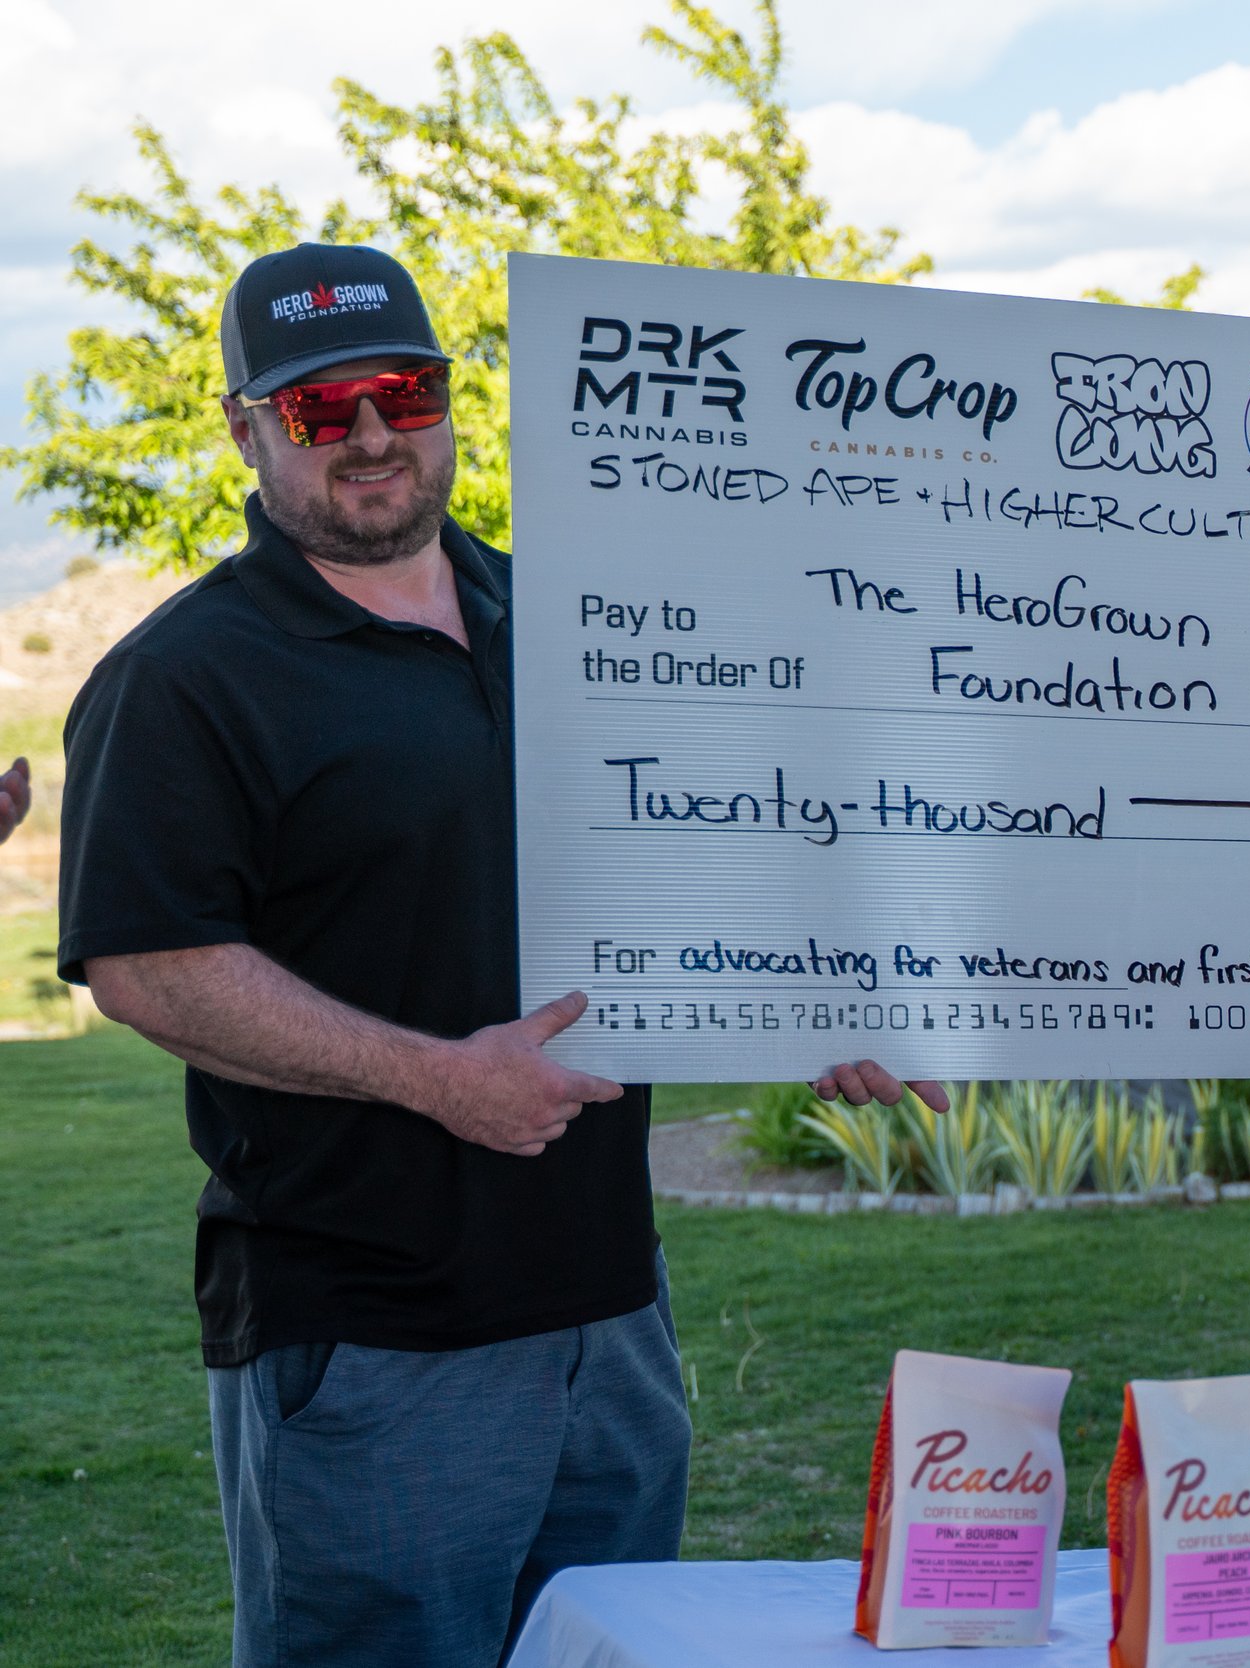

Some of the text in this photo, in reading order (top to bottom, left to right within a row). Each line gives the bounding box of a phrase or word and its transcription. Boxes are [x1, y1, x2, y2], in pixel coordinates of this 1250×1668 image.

[271, 284, 389, 319] HERO GROWN
[290, 302, 382, 322] FOUNDATION
[579, 316, 747, 373] DRK
[573, 367, 747, 423] MTR
[571, 421, 749, 447] CANNABIS
[809, 440, 1000, 466] CANNABIS CO.
[588, 450, 790, 506] STONED
[803, 468, 900, 506] APE
[940, 476, 1137, 534] HIGHER
[582, 595, 696, 636] Pay to
[805, 568, 1211, 648] The HeroGrown
[583, 649, 804, 689] the Order Of
[929, 646, 1217, 711] Foundation
[604, 756, 1107, 845] Twenty-thousand
[594, 940, 656, 973] For
[678, 936, 880, 994] advocating
[892, 942, 943, 980] for
[958, 946, 1110, 984] veterans
[1126, 956, 1187, 990] and
[911, 1429, 1053, 1495] Picacho
[923, 1506, 1039, 1521] COFFEE ROASTERS
[936, 1527, 1018, 1541] PINK BOURBON
[1177, 1534, 1224, 1550] COFFEE
[1219, 1567, 1248, 1579] PEACH
